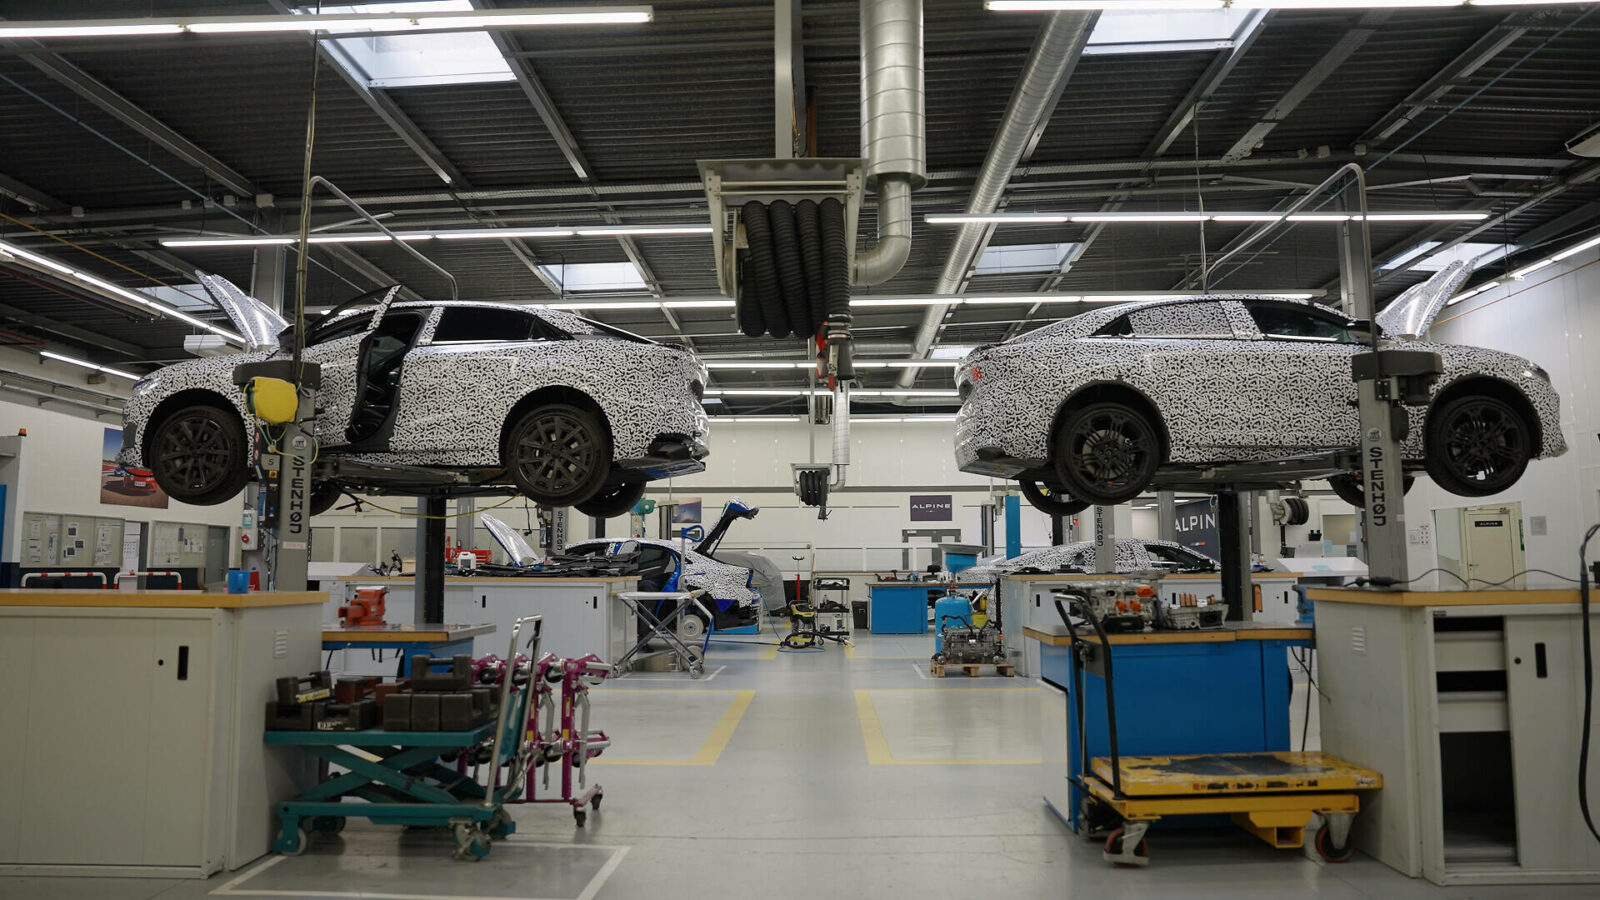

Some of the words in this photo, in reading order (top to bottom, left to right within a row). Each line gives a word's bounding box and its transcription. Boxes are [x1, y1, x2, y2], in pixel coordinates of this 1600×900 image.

[290, 456, 305, 534] STENHØJ
[1174, 512, 1216, 532] ALPIN
[1369, 447, 1387, 527] STENHØJ
